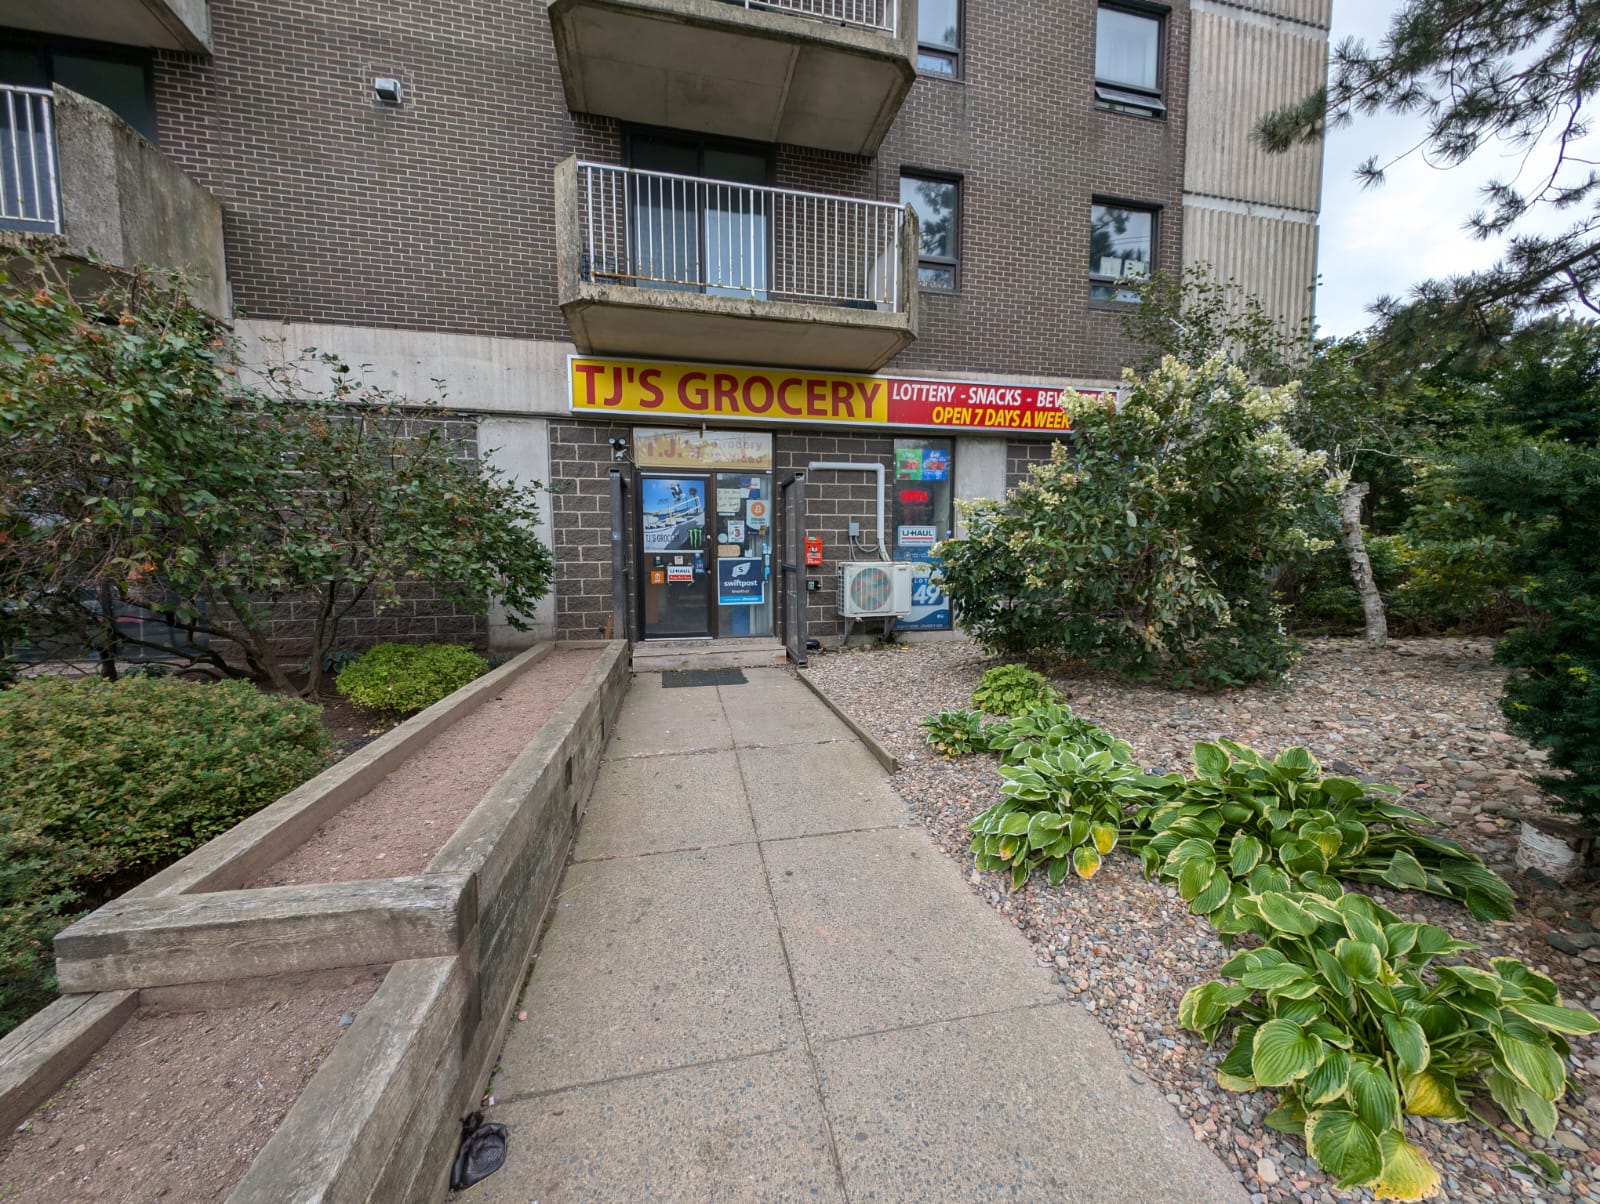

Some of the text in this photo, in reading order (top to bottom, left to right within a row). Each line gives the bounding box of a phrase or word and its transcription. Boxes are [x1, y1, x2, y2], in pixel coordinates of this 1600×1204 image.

[575, 364, 882, 418] TJ'S GROCERY
[892, 383, 956, 403] LOTTERY
[968, 386, 1022, 406] SNACKS
[932, 406, 973, 425] OPEN
[974, 409, 983, 425] 7
[985, 409, 1020, 427] DAYS
[1021, 411, 1032, 427] A
[899, 489, 929, 504] OPEN
[723, 579, 758, 588] swiftpost
